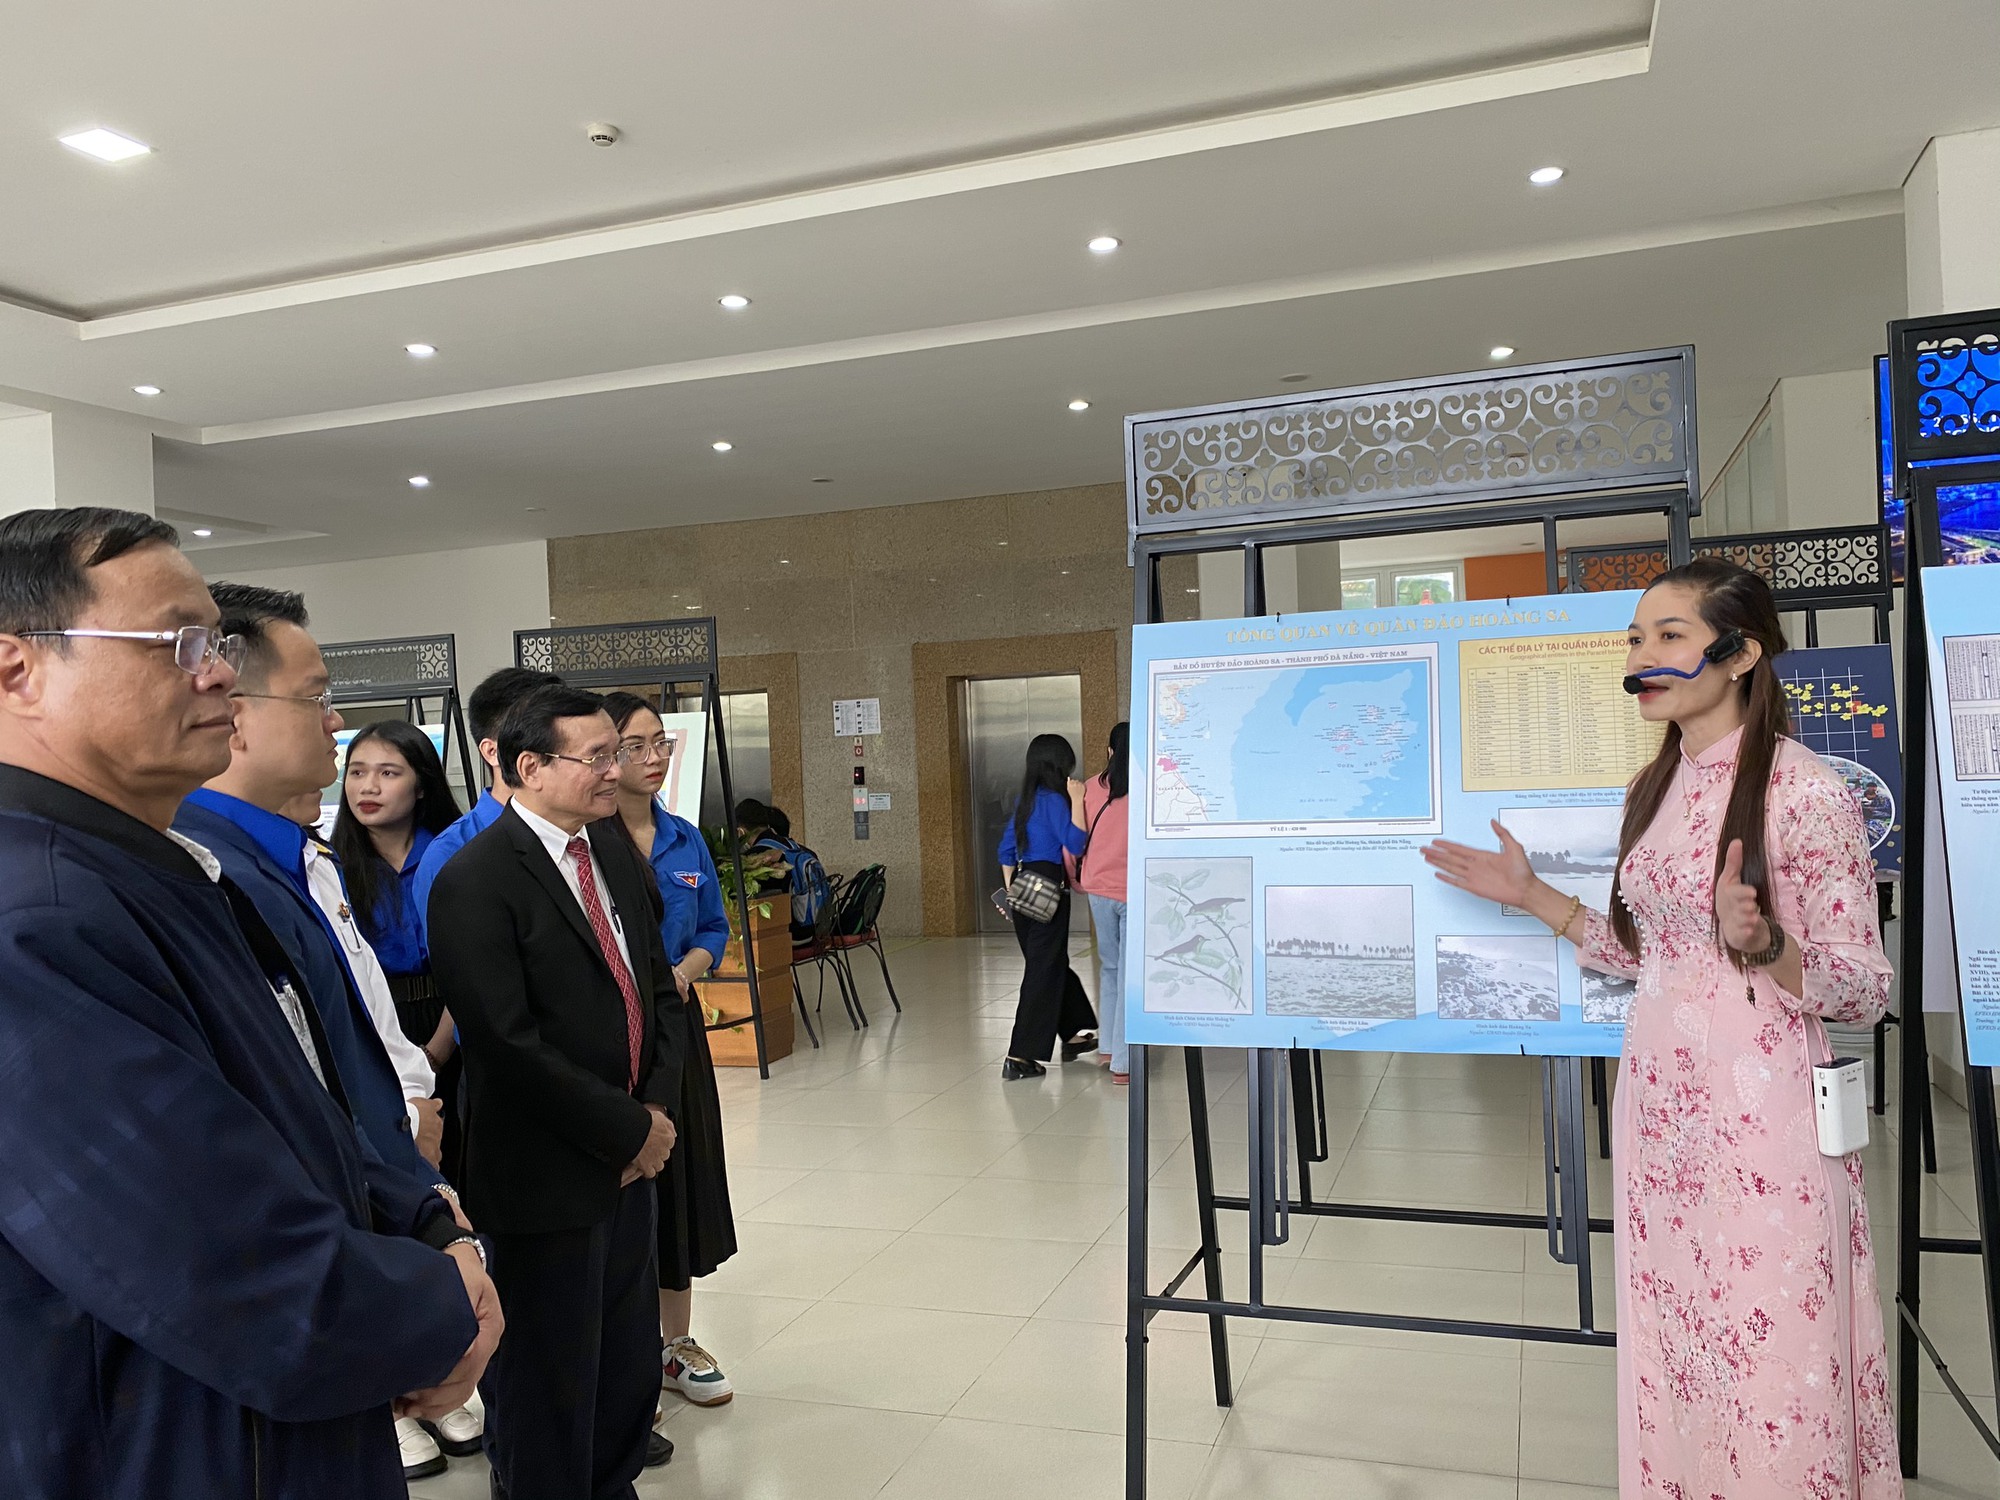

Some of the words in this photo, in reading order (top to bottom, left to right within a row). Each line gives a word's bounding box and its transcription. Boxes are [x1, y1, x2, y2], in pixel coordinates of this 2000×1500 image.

[1226, 627, 1275, 644] TỔNG
[1279, 625, 1331, 642] QUAN
[1335, 620, 1360, 636] VỀ
[1364, 614, 1418, 636] QUẦN
[1423, 613, 1463, 631] ĐẢO
[1469, 610, 1540, 627] HOÀNG
[1545, 609, 1571, 622] SA
[1479, 645, 1496, 655] CÁC
